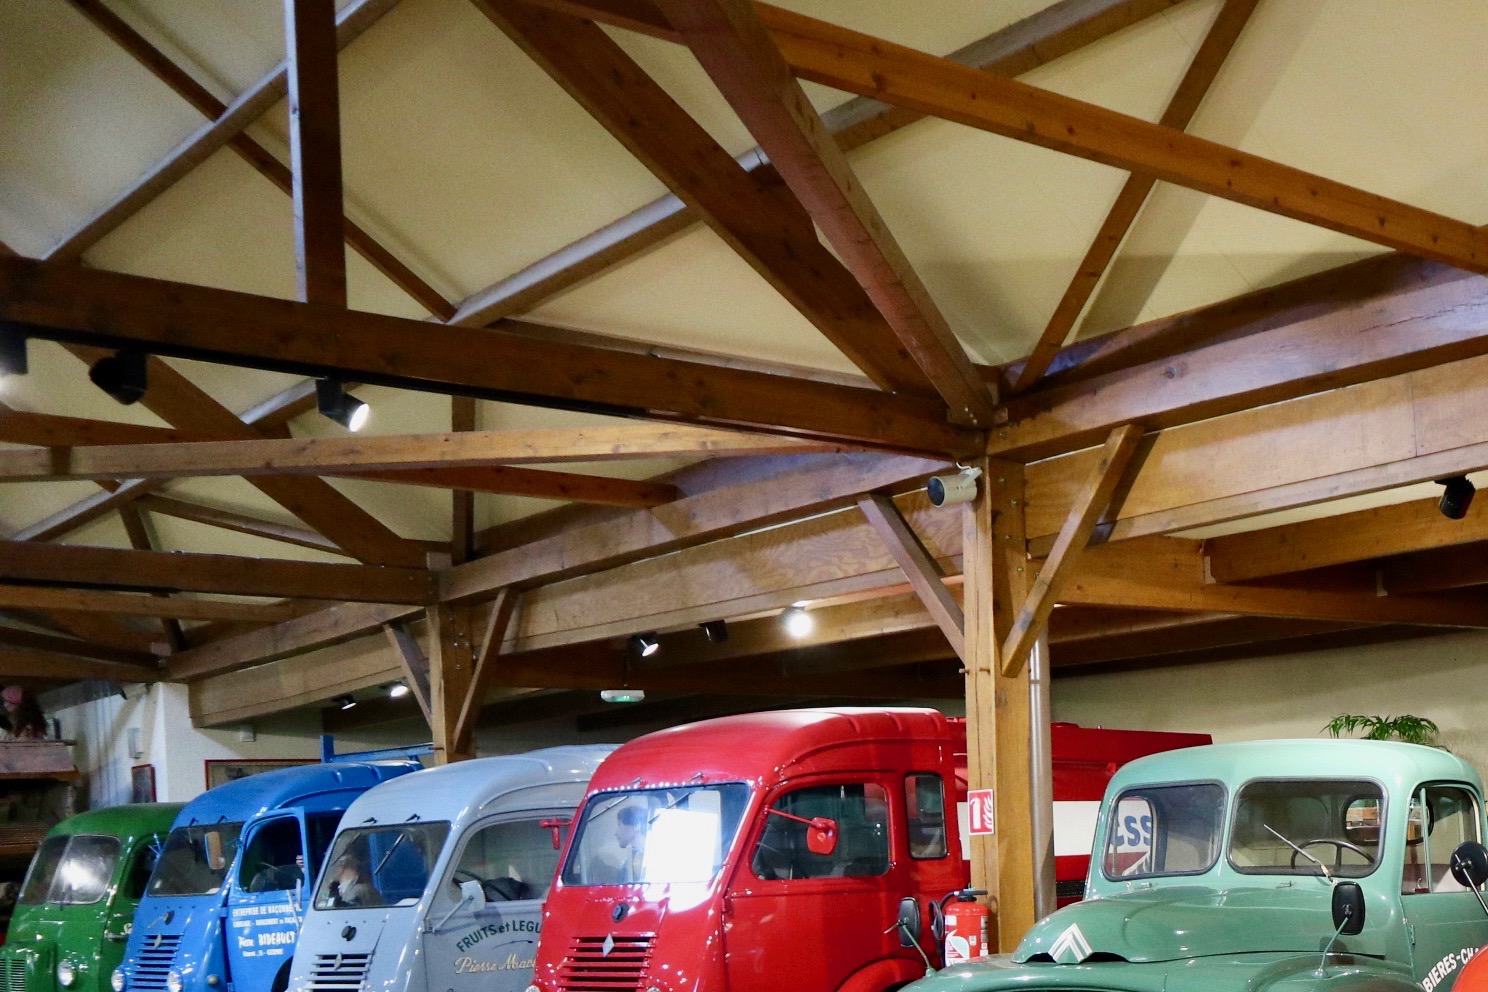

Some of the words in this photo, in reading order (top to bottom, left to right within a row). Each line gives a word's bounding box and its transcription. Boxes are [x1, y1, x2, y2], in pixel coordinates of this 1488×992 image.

[455, 924, 499, 953] FRUITS
[498, 922, 510, 934] et
[454, 956, 497, 975] Pierre
